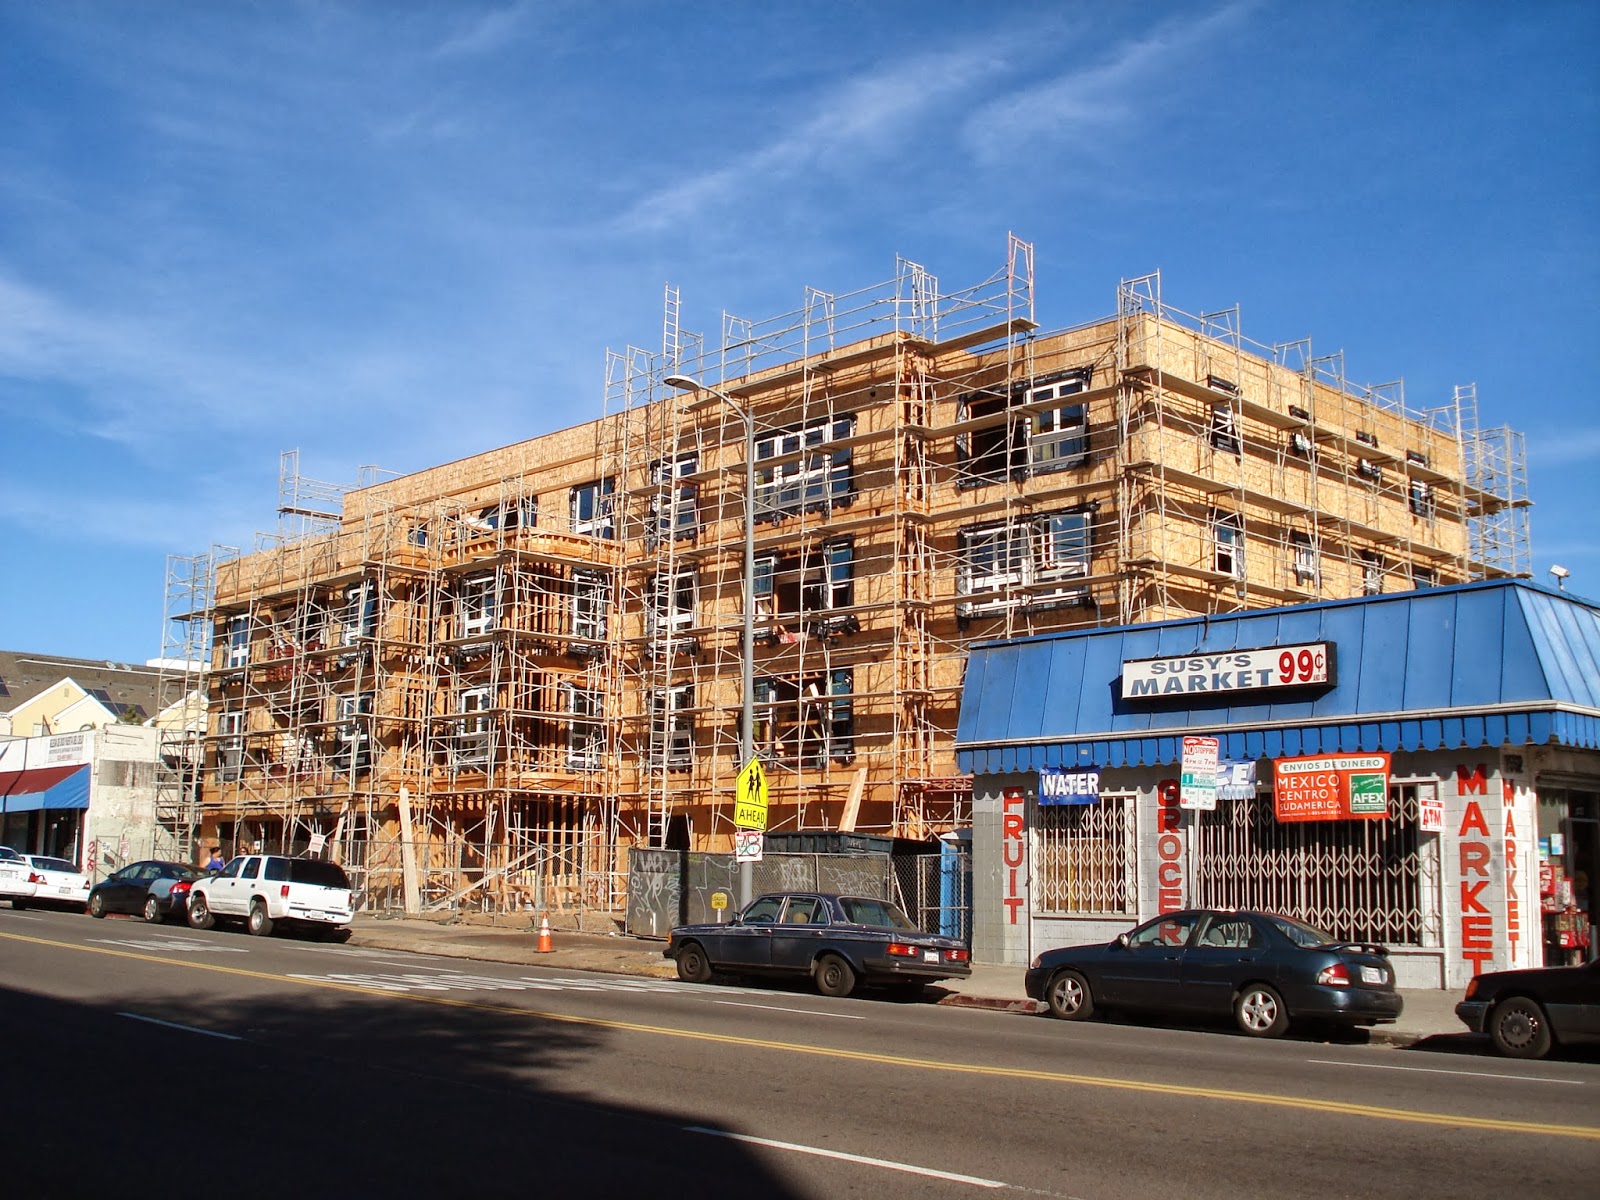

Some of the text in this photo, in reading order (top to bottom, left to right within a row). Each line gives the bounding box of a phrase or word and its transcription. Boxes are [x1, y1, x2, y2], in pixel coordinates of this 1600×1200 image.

[1150, 654, 1252, 675] SUSY'S
[1130, 668, 1274, 696] MARKET
[1184, 745, 1217, 755] NO STOPPING
[1283, 759, 1381, 772] ENVIOS DE DINERO
[1041, 772, 1099, 797] WATER
[1193, 777, 1215, 786] PARKING
[1278, 774, 1340, 789] MEXICO
[1279, 788, 1340, 801] CENTRO Y
[1352, 792, 1385, 804] AFEX
[1280, 800, 1342, 811] SUDAMERICA
[738, 808, 765, 824] AHEAD
[1422, 808, 1443, 827] ATM
[1003, 785, 1024, 925] FRUIT
[1457, 764, 1493, 977] MARKET
[1503, 778, 1520, 963] MARKET
